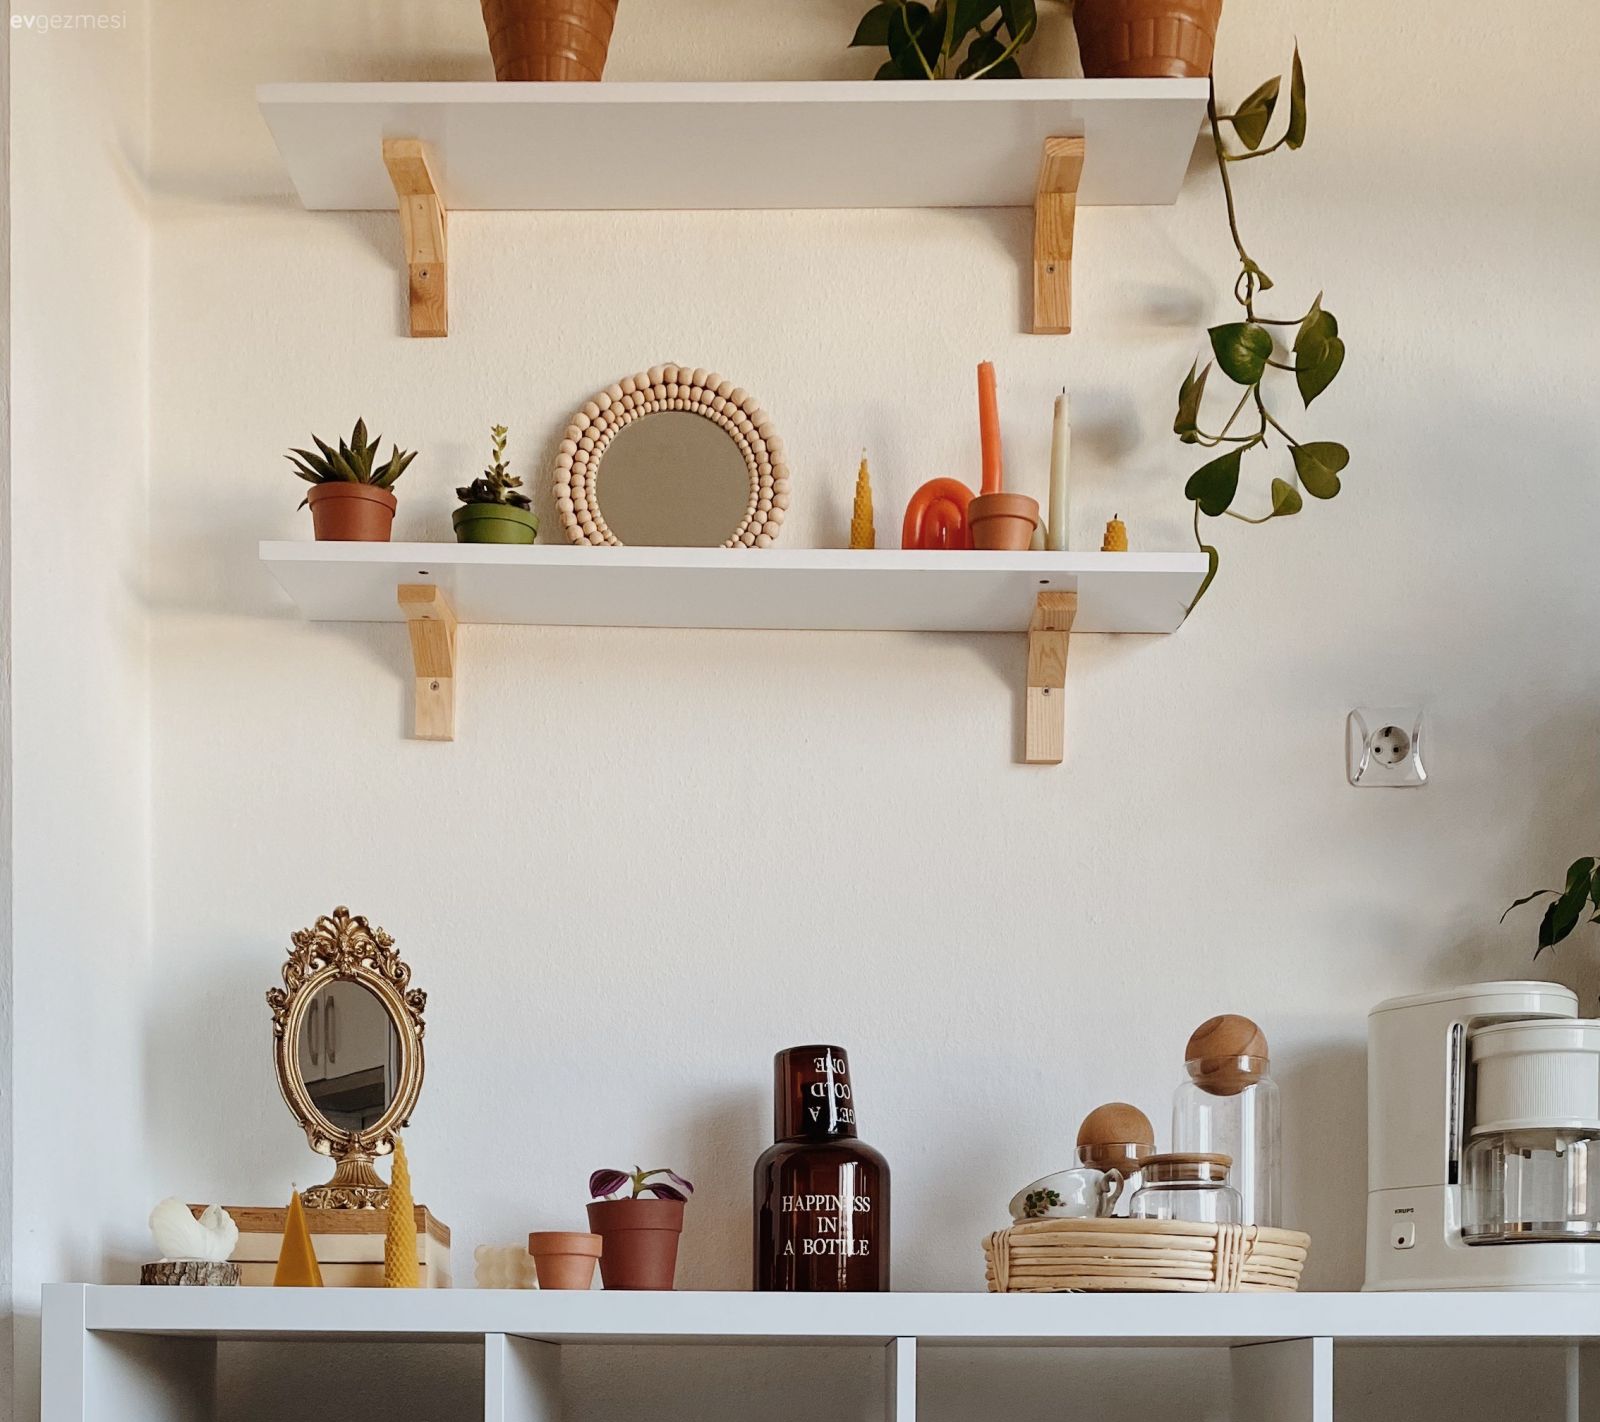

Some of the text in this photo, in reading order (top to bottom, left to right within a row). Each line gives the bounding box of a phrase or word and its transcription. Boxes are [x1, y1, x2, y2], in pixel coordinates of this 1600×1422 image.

[808, 1106, 821, 1122] A
[782, 1194, 871, 1213] HAPPINSS
[1394, 1207, 1415, 1215] KRUPS
[817, 1216, 838, 1234] IN
[783, 1239, 796, 1256] A
